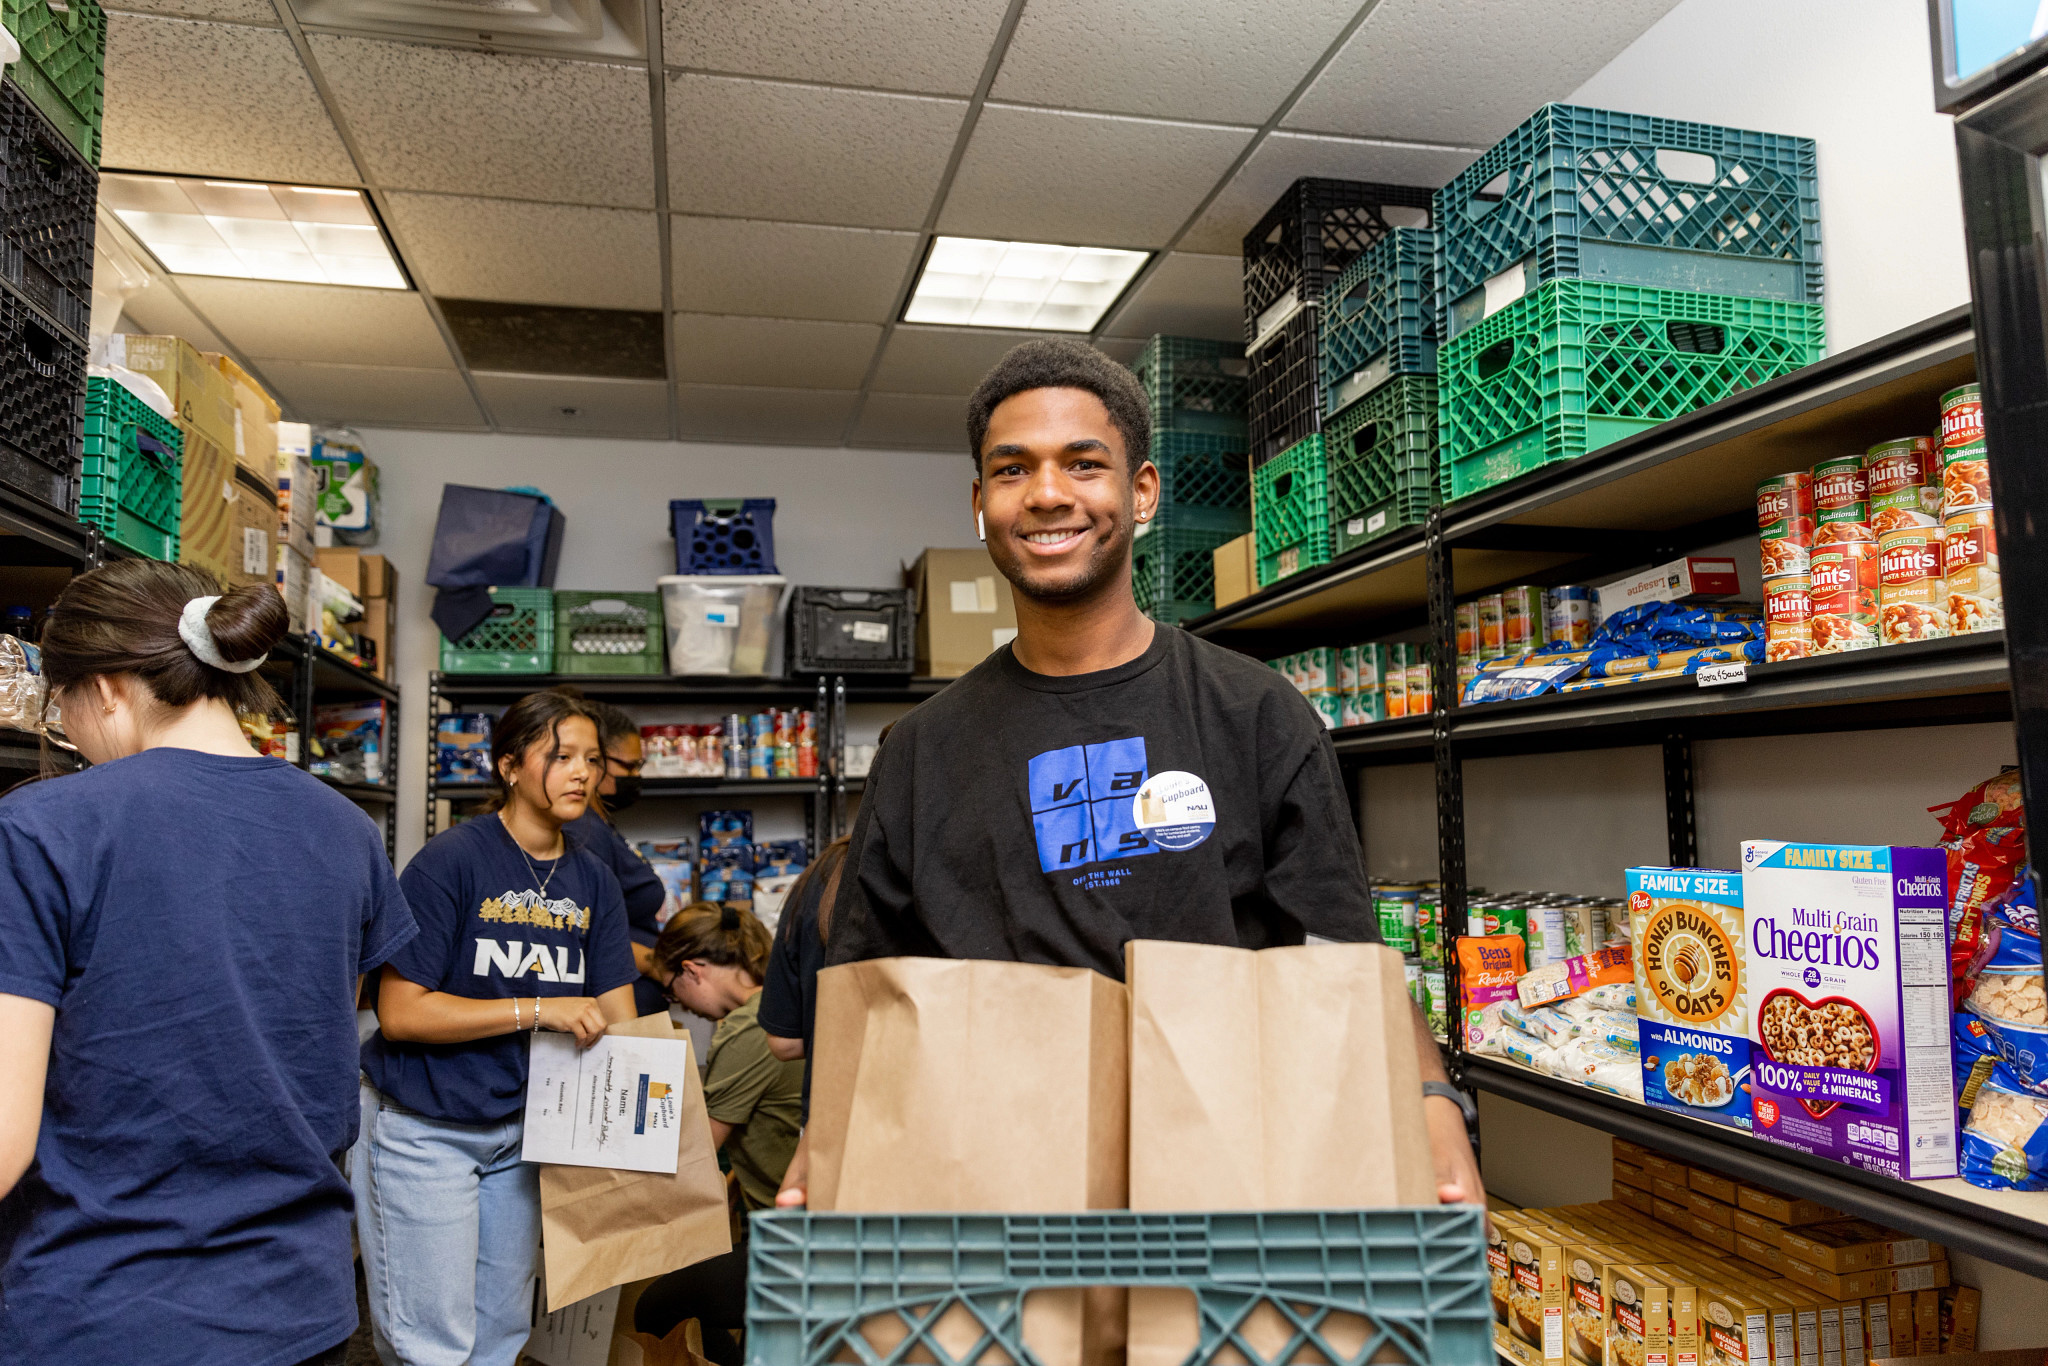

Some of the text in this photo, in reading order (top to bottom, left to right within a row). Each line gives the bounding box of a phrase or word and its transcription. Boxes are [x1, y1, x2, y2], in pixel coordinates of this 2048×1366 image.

[1946, 395, 1980, 408] PREMIUM
[1942, 408, 1984, 437] Hunt
[1944, 428, 1985, 444] PASTA SAUC
[1872, 449, 1903, 460] PREMIUM
[1946, 447, 1988, 462] Traditiona
[1817, 466, 1853, 478] PREMIUM
[1871, 478, 1911, 492] PASTA SAUCE
[1758, 495, 1789, 515] unt's
[1817, 493, 1859, 506] PASTA SAUCE
[1871, 498, 1887, 510] Garlic
[1895, 494, 1916, 503] Herb
[1764, 512, 1783, 520] SAUCE
[1820, 509, 1859, 522] Traditional
[1885, 539, 1919, 549] PREMIUM
[1946, 540, 1978, 561] unt's
[1881, 550, 1935, 574] Hunt's
[1950, 557, 1970, 568] SAUCE
[1883, 569, 1928, 581] PASTA SAUCE
[1950, 577, 1972, 588] Cheese
[1627, 577, 1666, 597] Lasagne
[1775, 585, 1808, 593] PREMIUM
[1821, 584, 1844, 593] SAUCE
[1884, 588, 1928, 600] Four Cheese
[1769, 595, 1812, 614] Hunt
[1815, 602, 1830, 612] Meat
[1773, 612, 1791, 620] PASTA
[1698, 669, 1717, 683] Pasta
[1721, 669, 1744, 680] Sauce
[1161, 783, 1205, 804] Cupboard
[1187, 804, 1208, 812] NAU
[1785, 848, 1873, 869] FAMILY SIZE
[1088, 870, 1104, 880] THE
[1107, 868, 1132, 878] WALL
[1852, 875, 1887, 886] Gluten Free
[1955, 861, 1981, 901] FRUTAS
[1639, 874, 1730, 896] FAMILY SIZE
[1897, 878, 1943, 897] Cheerios
[1631, 894, 1650, 910] Post
[1958, 872, 1992, 943] FRUIT RINGS
[1792, 907, 1879, 933] Multi Grain
[1647, 911, 1732, 982] HONEY BUNCHES
[1752, 917, 1880, 971] Cheerios
[473, 937, 586, 984] NAU
[1482, 959, 1513, 972] Original
[1599, 949, 1613, 969] riginal
[1427, 976, 1446, 985] Gree
[1781, 970, 1847, 984] WHOLE GRAIN
[1805, 976, 1820, 984] grains
[1430, 984, 1446, 992] Gia
[1490, 989, 1513, 998] JASMINE
[1675, 987, 1725, 1016] OATS
[1651, 1028, 1733, 1055] with ALMONDS
[1758, 1062, 1803, 1092] 100%
[1803, 1079, 1821, 1087] VALUE
[1824, 1072, 1878, 1091] 9 VITAMINS
[1821, 1084, 1882, 1104] & MINERALS
[618, 1088, 629, 1117] Name:
[666, 1096, 675, 1120] Louie's
[659, 1097, 669, 1129] Cupboard
[1753, 1130, 1814, 1154] Lightly Sweetened Cereal
[1852, 1151, 1863, 1161] NET
[1863, 1153, 1873, 1163] WT
[1877, 1157, 1886, 1167] LB
[1886, 1160, 1891, 1168] 2
[1891, 1161, 1900, 1170] OZ
[1494, 1259, 1508, 1271] CHEESE
[1517, 1267, 1539, 1282] MACARONI
[1524, 1278, 1540, 1290] CHEESE
[1577, 1286, 1600, 1303] MACARONI
[1584, 1297, 1601, 1310] CHEESE
[1619, 1308, 1641, 1325] MACARONI
[1627, 1320, 1642, 1334] CHEESE
[1714, 1331, 1741, 1350] MACARONI
[1719, 1341, 1743, 1359] & CHEESE
